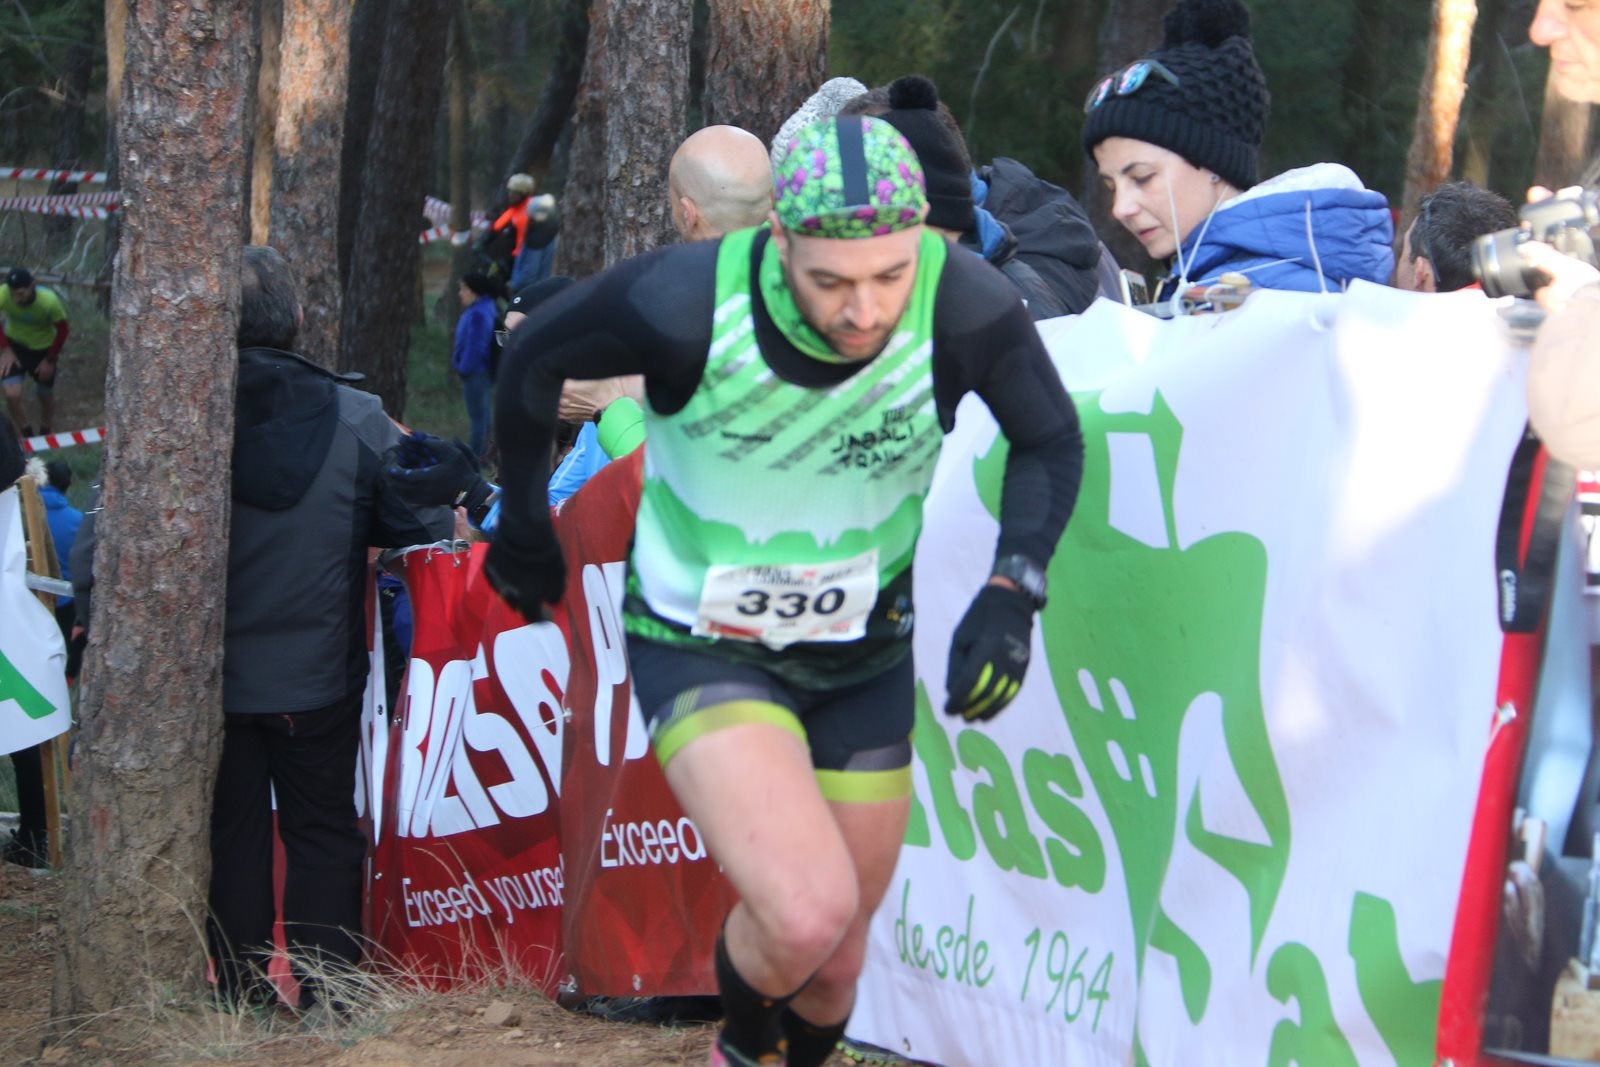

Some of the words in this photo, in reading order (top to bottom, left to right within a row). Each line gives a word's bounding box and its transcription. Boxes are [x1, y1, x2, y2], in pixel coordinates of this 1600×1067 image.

[737, 586, 845, 618] 330
[402, 871, 492, 928] Exceed
[895, 878, 995, 987] desde
[1020, 927, 1114, 1033] 1964
